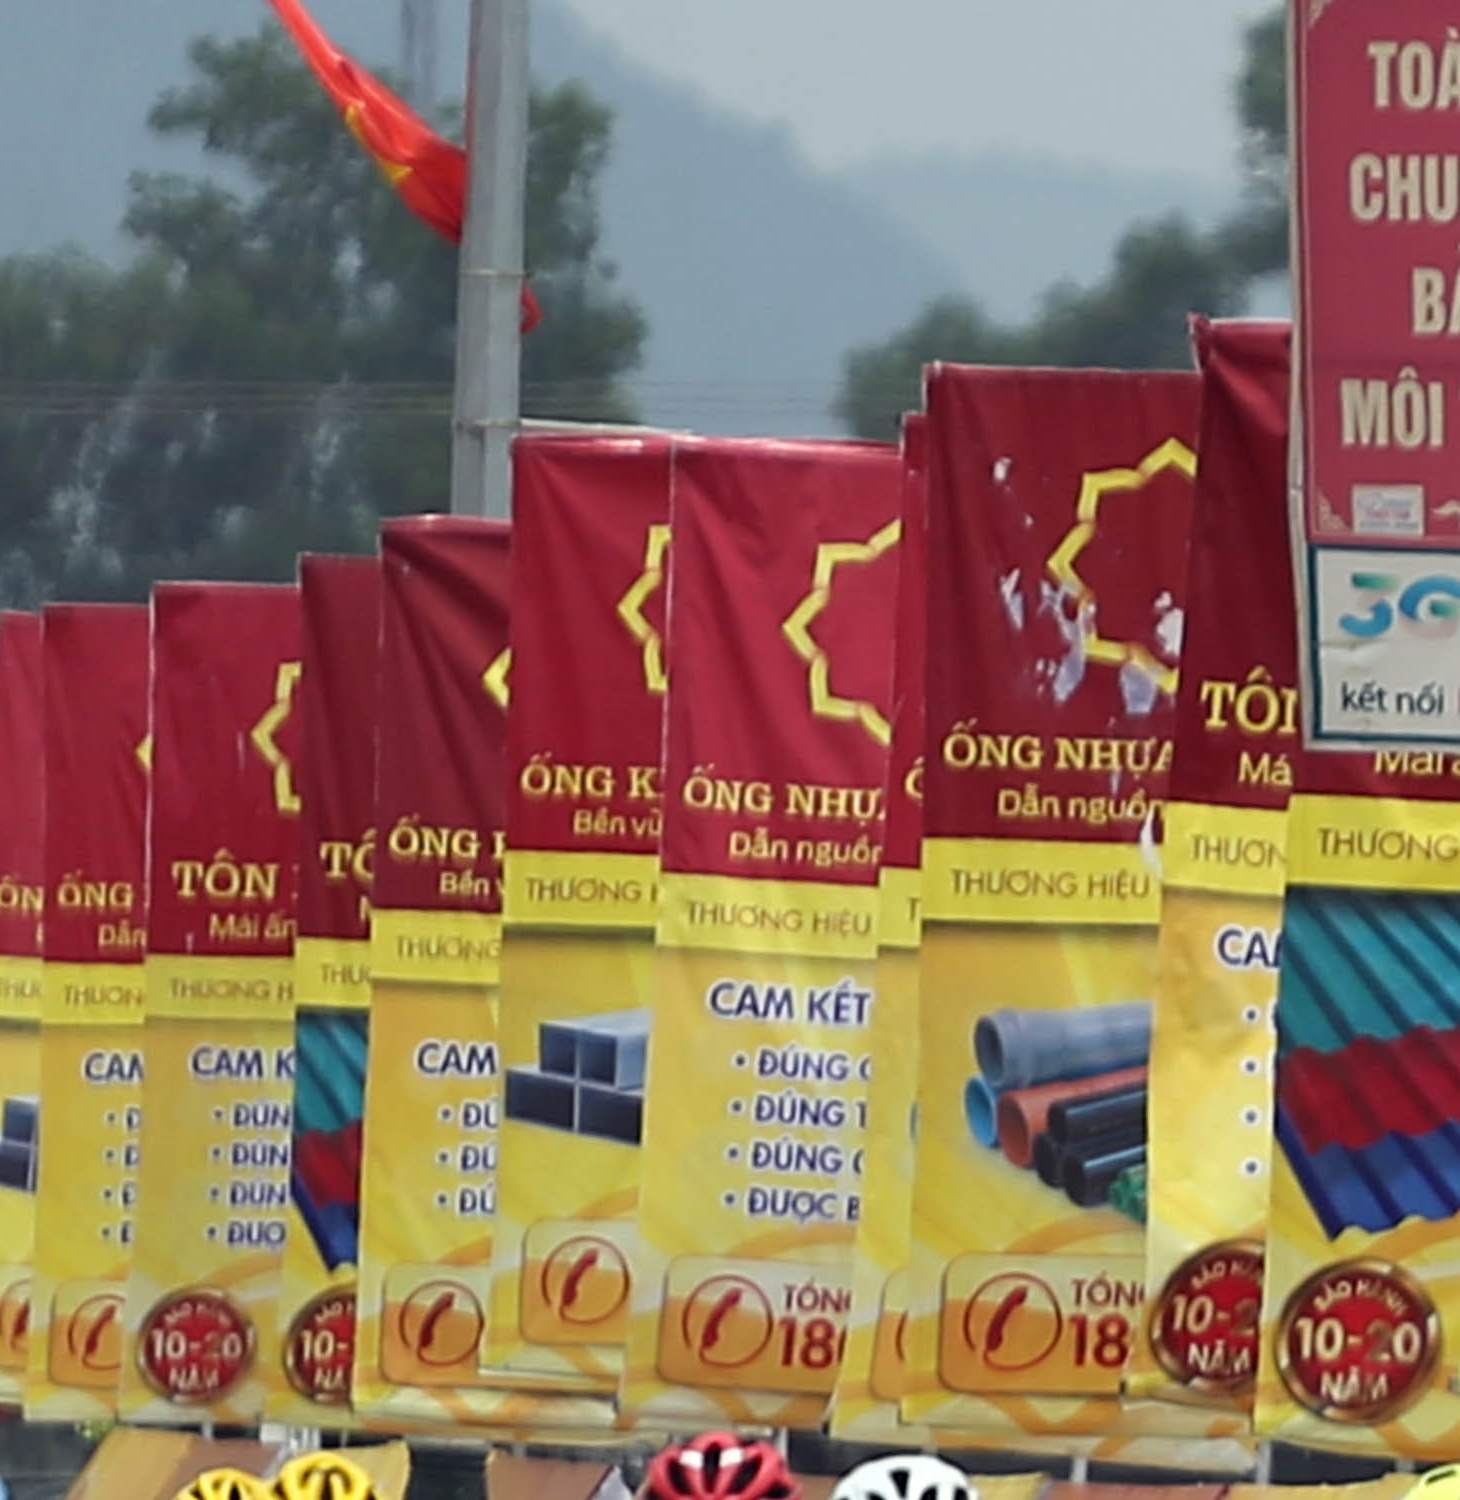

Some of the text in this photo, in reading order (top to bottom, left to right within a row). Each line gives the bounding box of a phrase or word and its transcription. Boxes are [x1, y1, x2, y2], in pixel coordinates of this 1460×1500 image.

[1341, 369, 1443, 453] MÔI
[1341, 681, 1389, 715] kết
[1396, 682, 1444, 716] nối
[944, 718, 1044, 770] ỐNG
[520, 751, 616, 798] ỐNG
[683, 762, 887, 827] ỐNG NHỰ
[998, 782, 1061, 819] Dẫn
[389, 813, 482, 860] ỐNG
[573, 807, 626, 837] Bền
[729, 826, 788, 861] Dẫn
[1319, 827, 1459, 862] THƯƠNG
[57, 869, 134, 911] ỐNG
[171, 847, 280, 899] TÔN
[951, 867, 1151, 901] THƯƠNG HIỆU
[689, 901, 873, 940] THƯƠNG HIỆU
[710, 979, 871, 1025] CAM KẾT
[192, 1047, 265, 1079] CAM
[417, 1042, 497, 1075] CAM
[759, 1043, 849, 1082] ĐÚNG
[755, 1089, 846, 1128] ĐÚNG
[751, 1136, 843, 1174] ĐÚNG
[1295, 1316, 1422, 1364] 10-20
